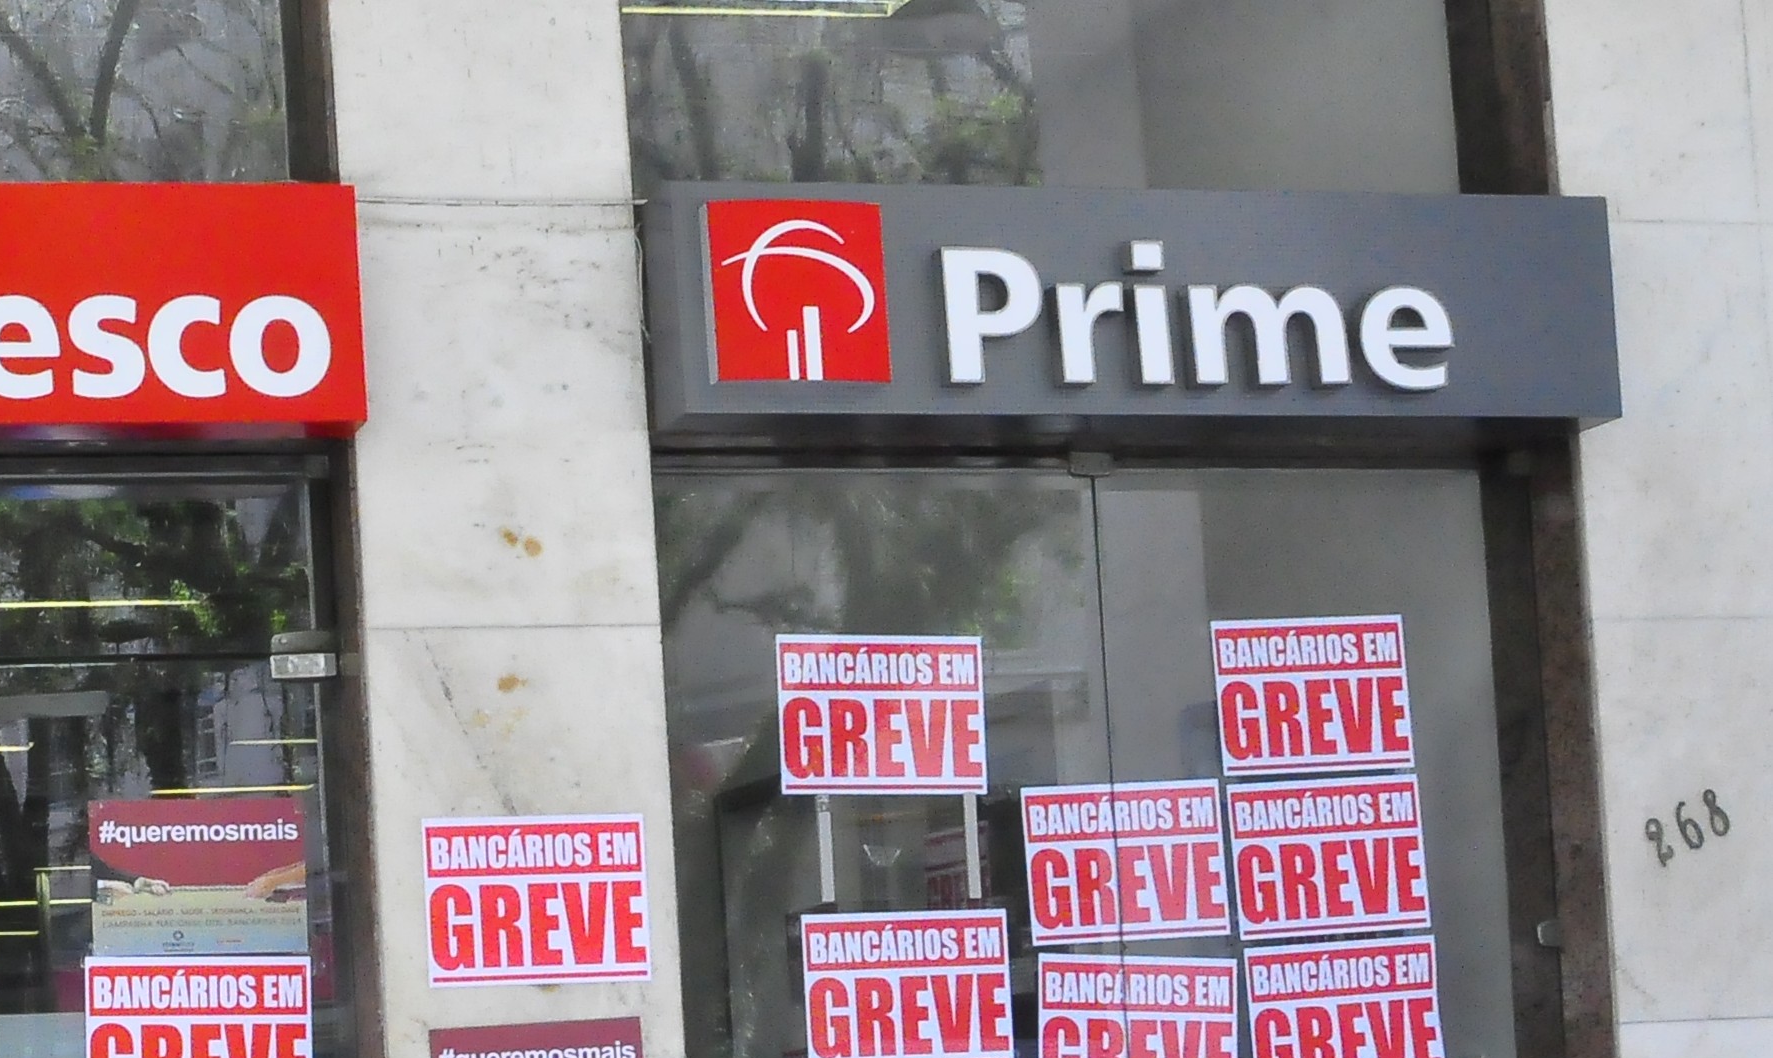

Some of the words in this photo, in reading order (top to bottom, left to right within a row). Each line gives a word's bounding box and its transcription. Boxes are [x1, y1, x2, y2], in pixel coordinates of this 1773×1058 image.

[939, 239, 1454, 390] Prime
[783, 645, 932, 684] BANCÁRIOS
[938, 653, 975, 684] EM
[1219, 629, 1358, 667] BANCÁRIOS
[1363, 631, 1398, 663] EM
[782, 697, 981, 778] GREVE
[1221, 676, 1409, 760] GREVE
[1029, 796, 1174, 834] BANCÁRIOS
[1179, 795, 1213, 827] EM
[1236, 791, 1375, 831] BANCÁRIOS
[1379, 791, 1413, 823] EM
[98, 818, 299, 848] #queremosmais
[430, 830, 592, 870] BANCÁRIOS
[598, 832, 637, 865] EM
[1031, 841, 1225, 929] GREVE
[1237, 836, 1425, 924] GREVE
[430, 880, 647, 970] GREVE
[809, 924, 957, 964] BANCÁRIOS
[964, 926, 1000, 958] EM
[93, 970, 256, 1010] BANCÁRIOS
[263, 974, 302, 1007] EM
[1045, 966, 1191, 1006] BANCÁRIOS
[1195, 976, 1228, 1007] EM
[1253, 955, 1390, 994] BANCÁRIOS
[1395, 952, 1428, 983] EM
[808, 972, 1010, 1058] GREVE
